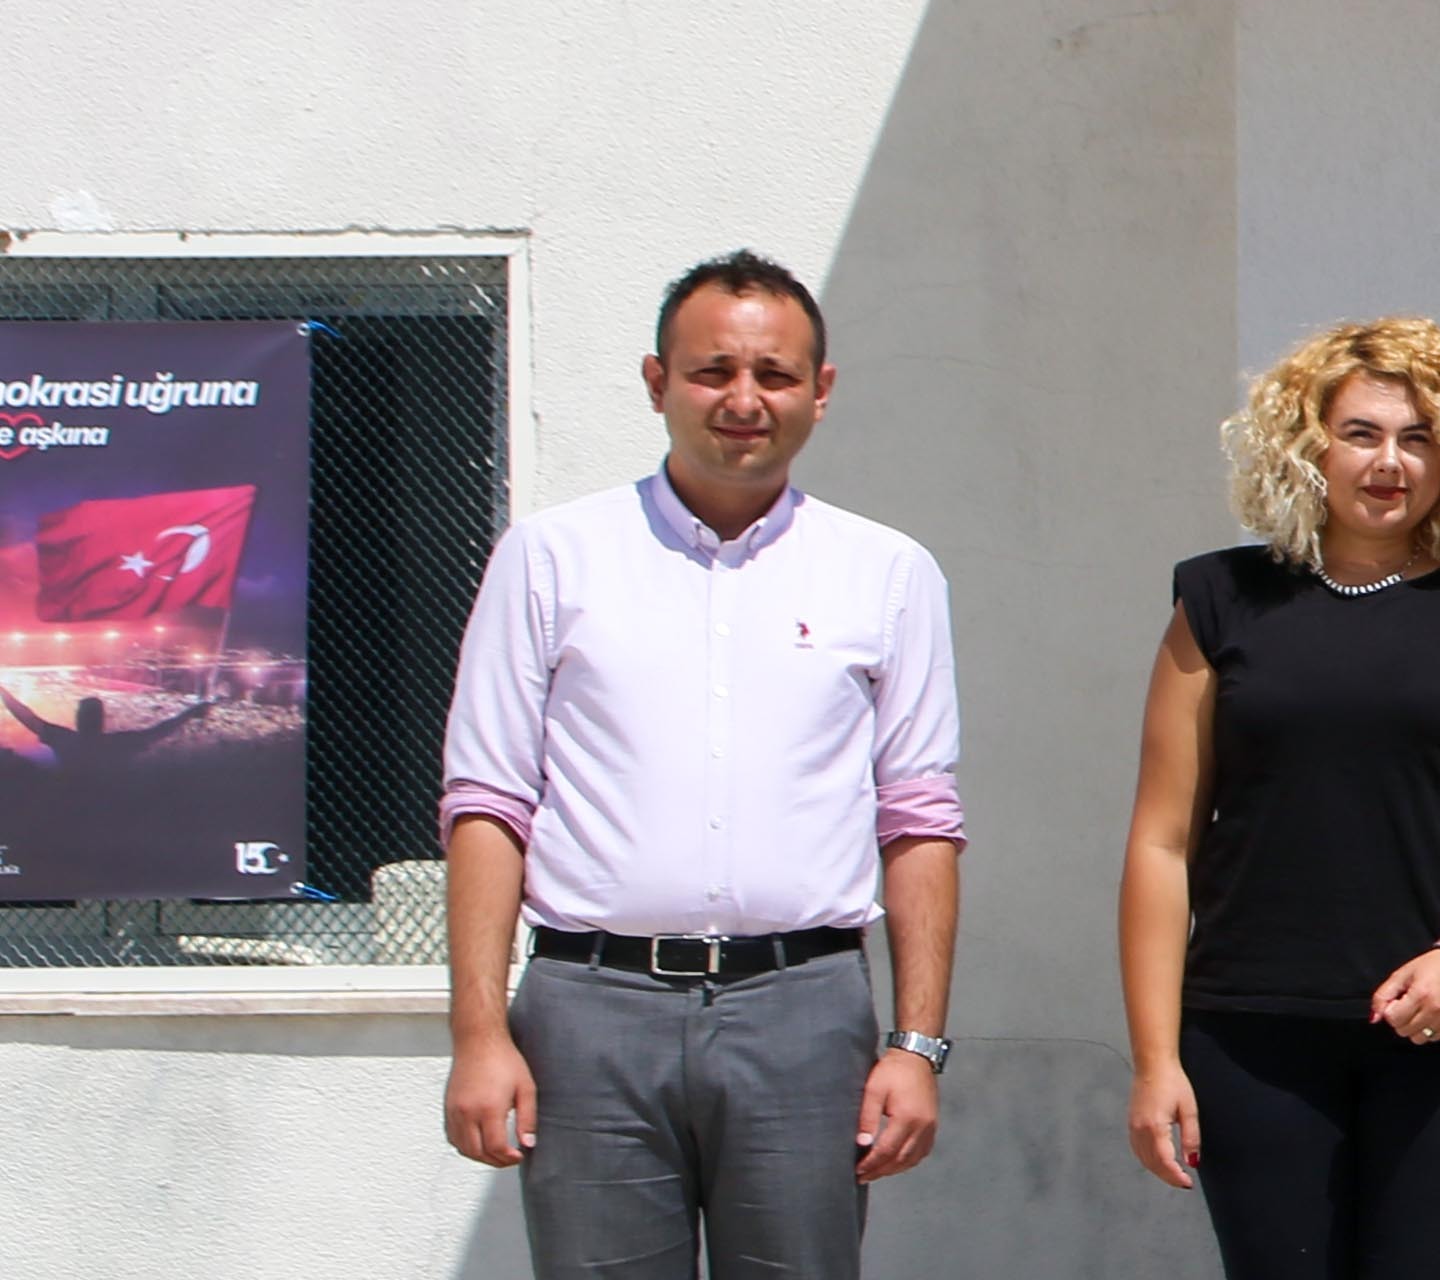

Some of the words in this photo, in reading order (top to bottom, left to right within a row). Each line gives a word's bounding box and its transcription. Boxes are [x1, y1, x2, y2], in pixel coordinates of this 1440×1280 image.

[0, 374, 124, 407] okrasi
[125, 371, 259, 414] uğruna
[18, 422, 109, 450] aşkına
